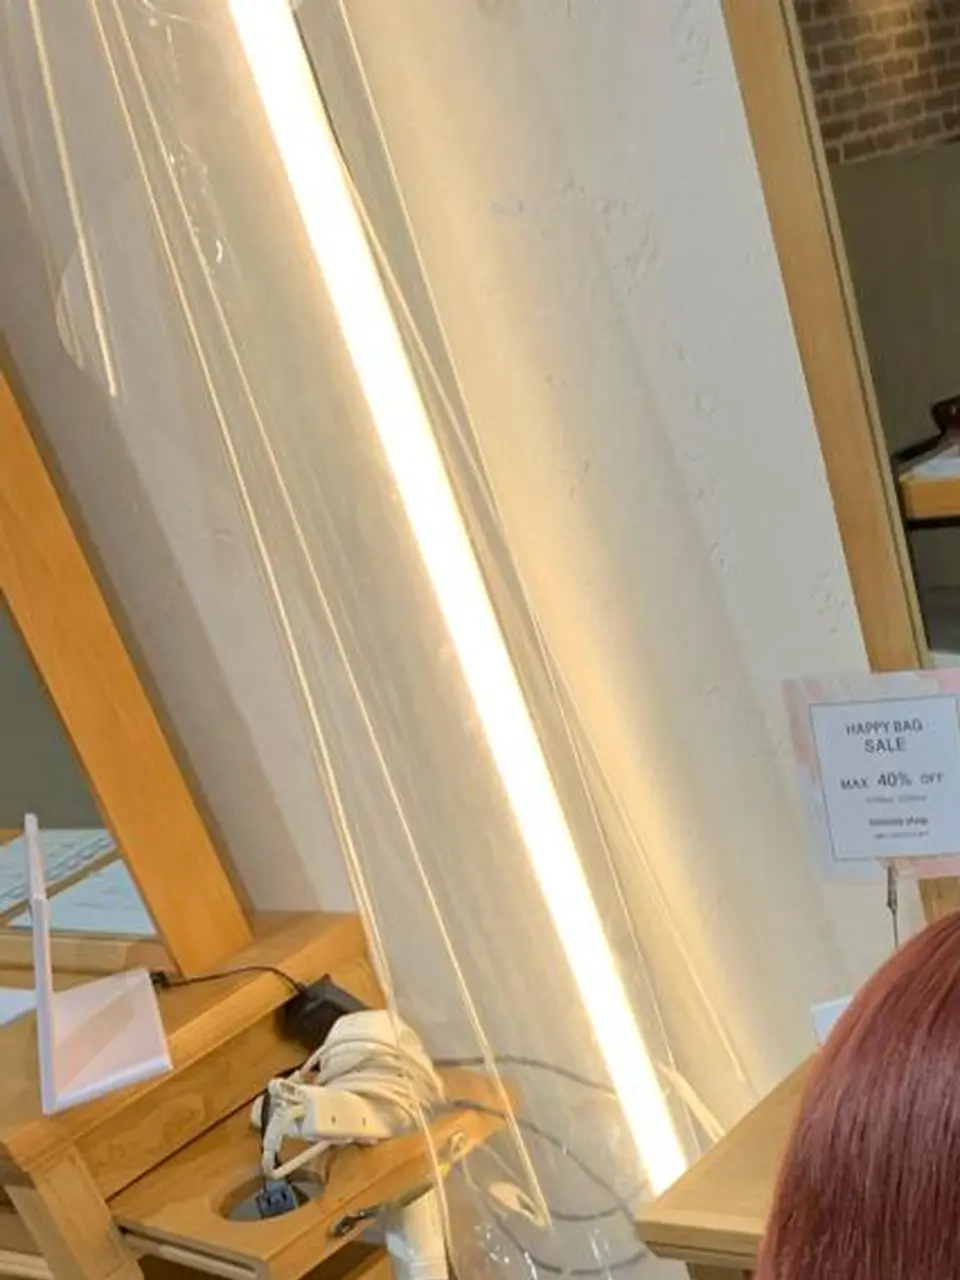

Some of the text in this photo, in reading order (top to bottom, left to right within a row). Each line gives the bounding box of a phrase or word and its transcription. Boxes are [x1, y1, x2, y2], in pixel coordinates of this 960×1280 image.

[845, 718, 923, 736] HAPPY BAG
[864, 736, 907, 754] SALE
[840, 771, 943, 790] MAX 40% OFF
